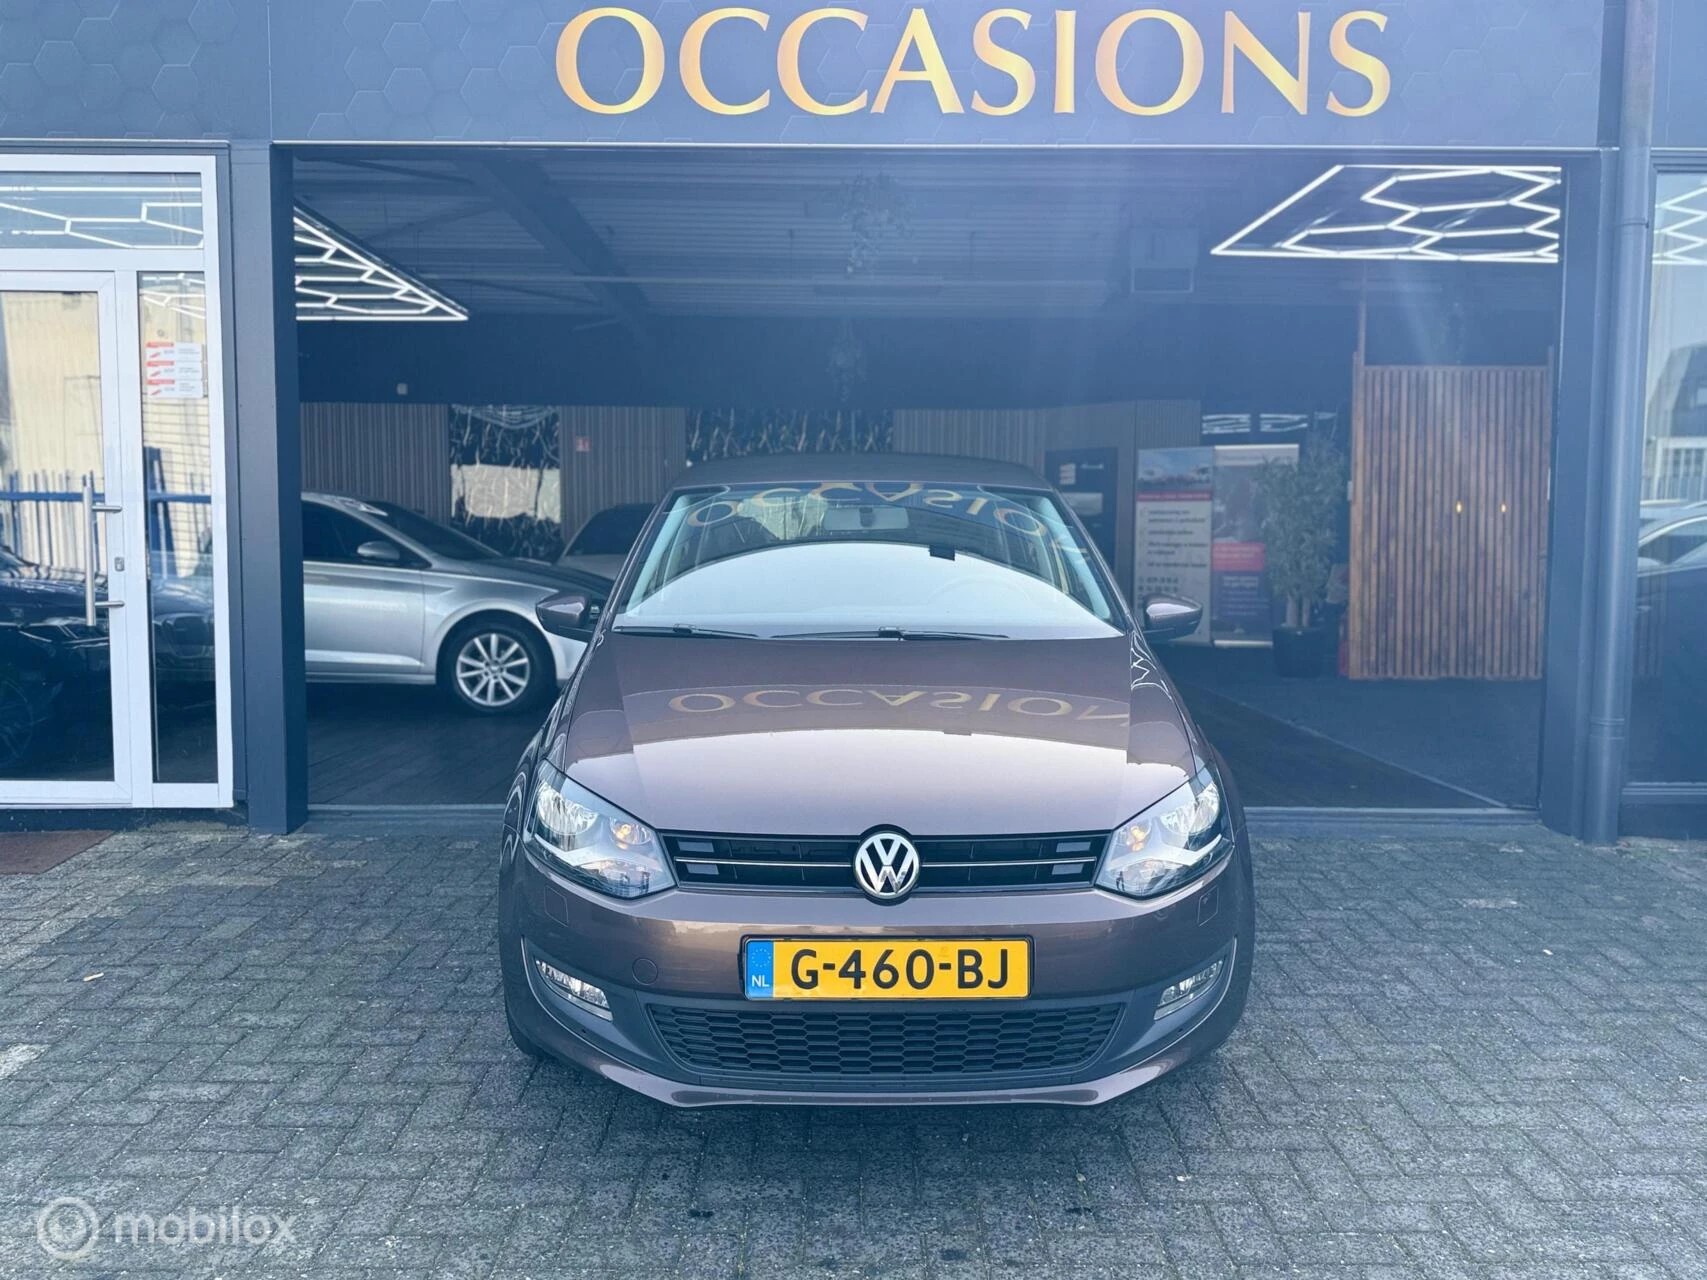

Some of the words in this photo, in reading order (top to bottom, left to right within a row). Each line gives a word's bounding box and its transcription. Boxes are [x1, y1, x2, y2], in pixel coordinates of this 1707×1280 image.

[555, 7, 1392, 117] OCCASIONS
[855, 833, 919, 898] VW
[752, 974, 770, 988] NL
[791, 949, 1008, 989] G-460-BJ
